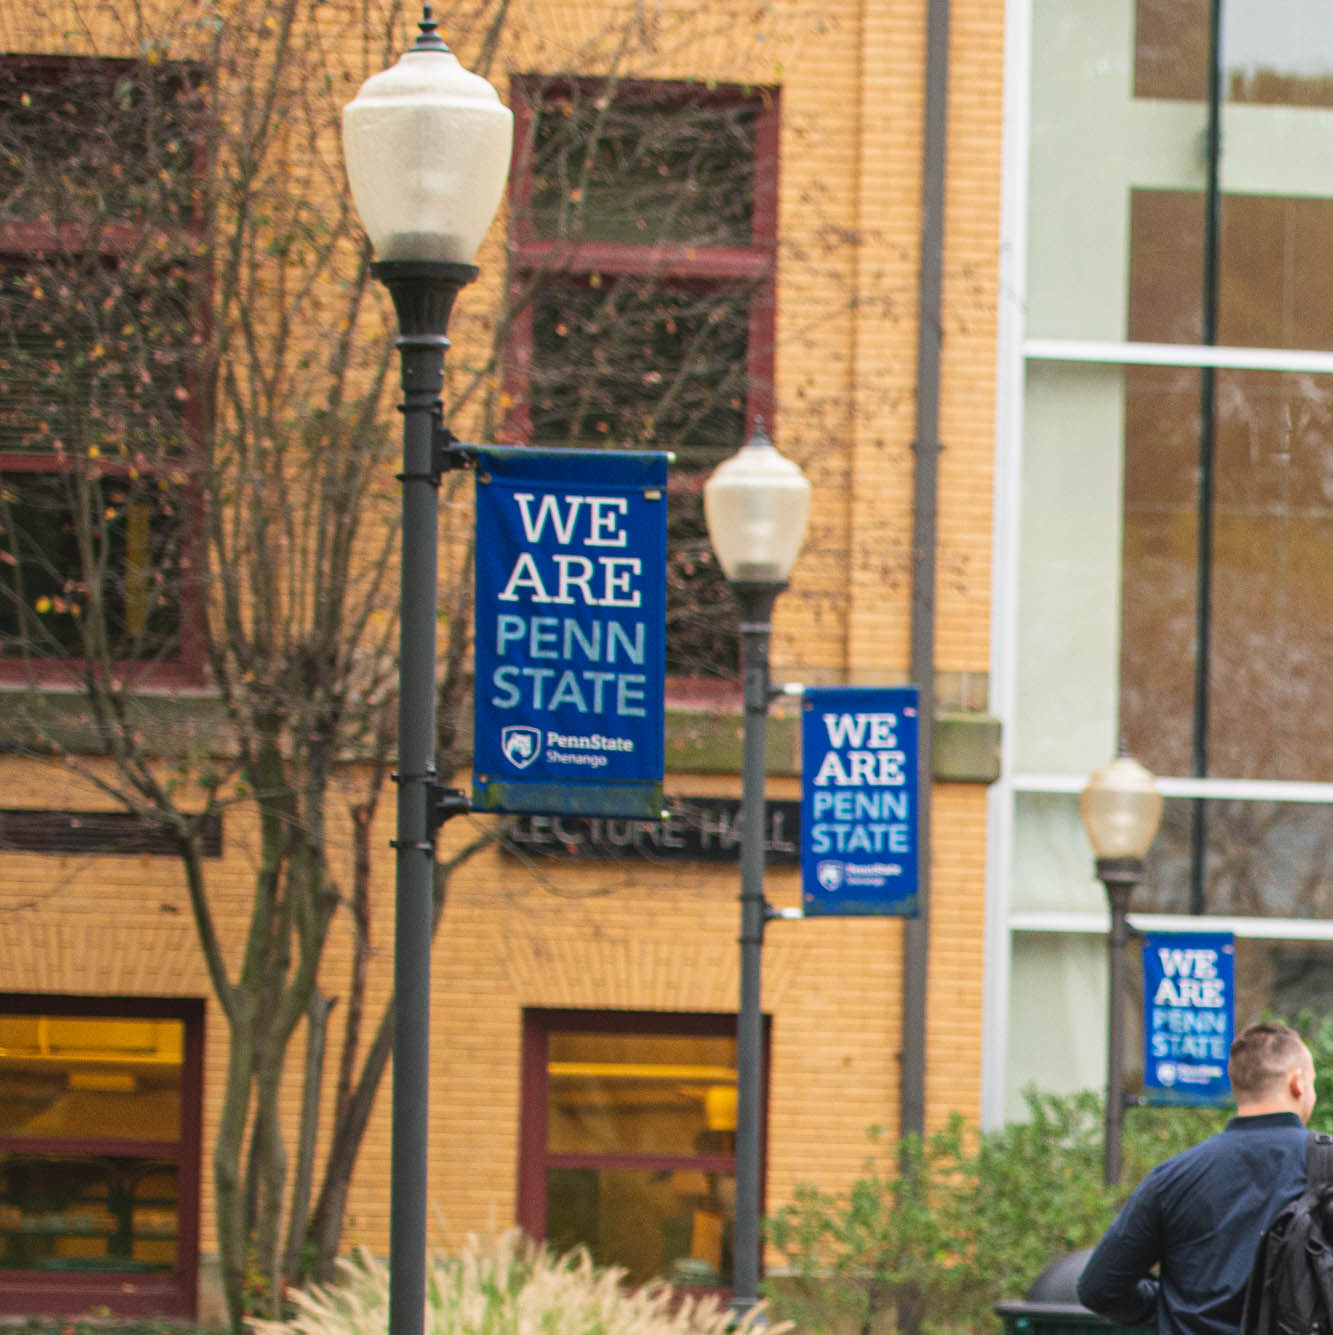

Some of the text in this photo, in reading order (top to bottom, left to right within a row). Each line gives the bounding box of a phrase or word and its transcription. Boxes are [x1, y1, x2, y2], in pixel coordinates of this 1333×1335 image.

[514, 493, 627, 546] WE
[498, 552, 640, 607] ARE
[496, 615, 645, 664] PENN
[492, 666, 645, 716] STATE
[547, 732, 632, 751] PennState
[824, 713, 896, 748] WE
[546, 751, 608, 768] Shenango
[814, 751, 904, 785] ARE
[814, 792, 906, 819] PENN
[812, 824, 908, 852] STATE
[1159, 949, 1217, 977] WE
[1155, 976, 1224, 1007] ARE
[1154, 1009, 1225, 1032] PENN
[1152, 1032, 1224, 1058] STATE
